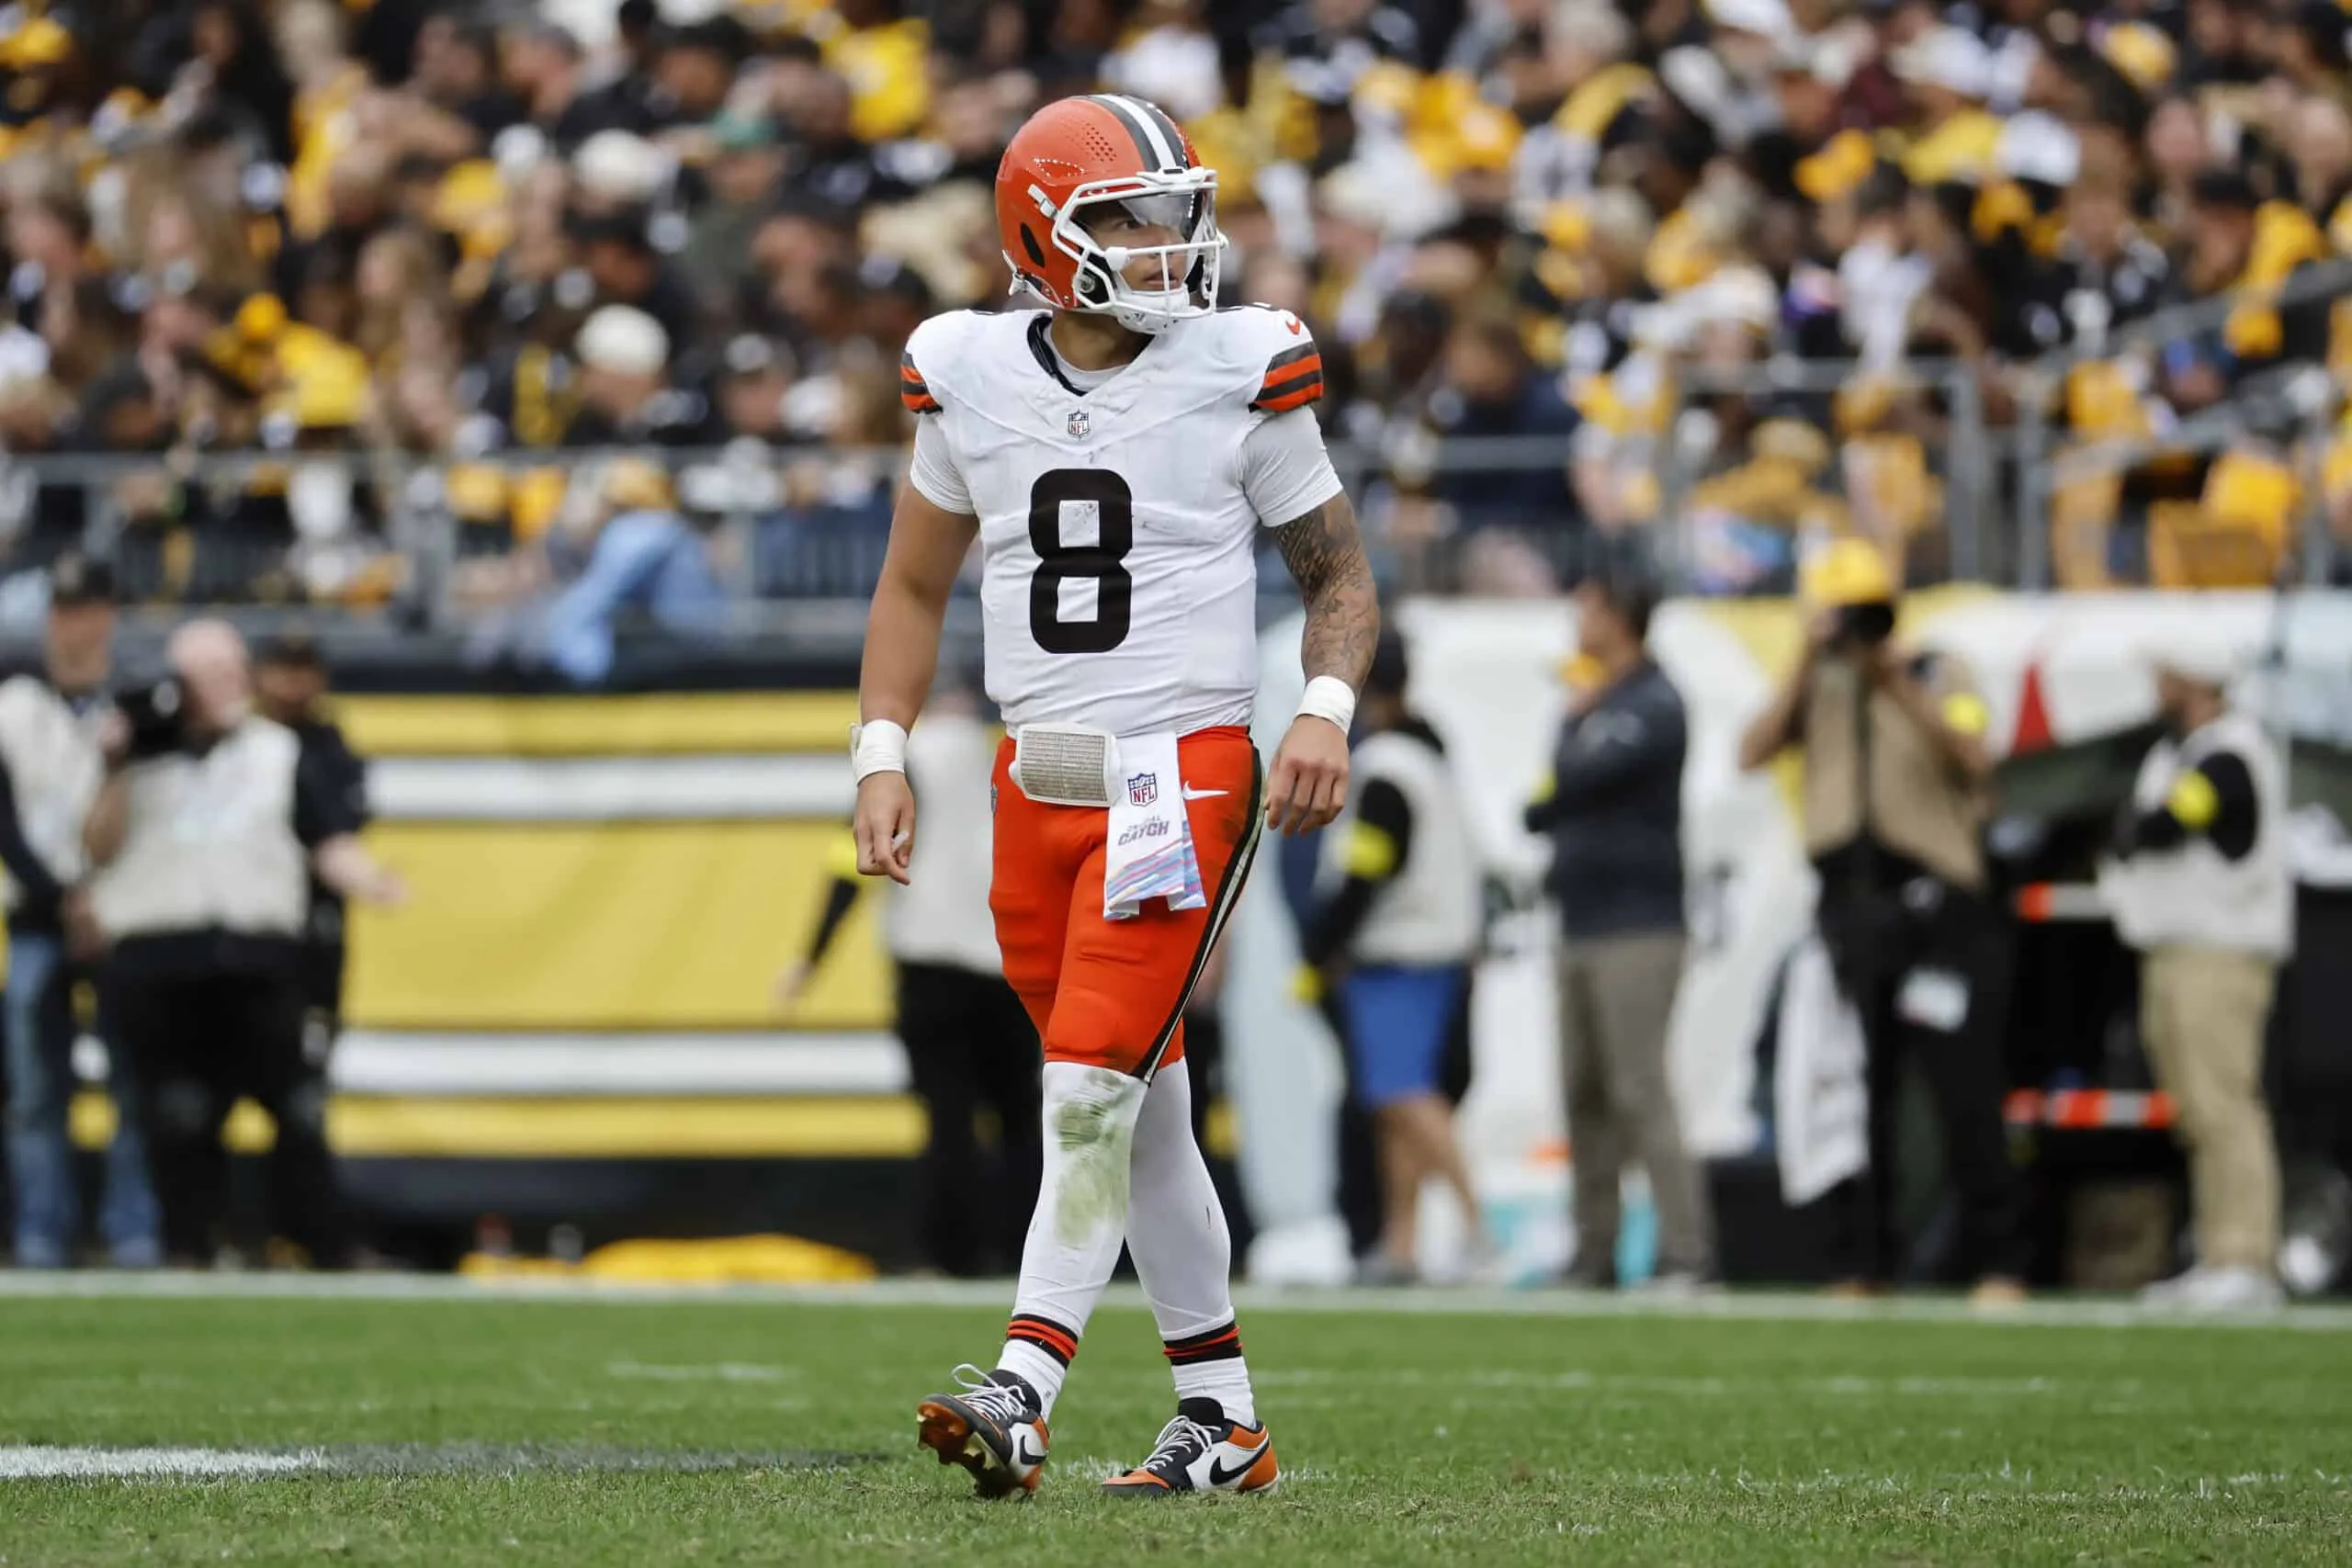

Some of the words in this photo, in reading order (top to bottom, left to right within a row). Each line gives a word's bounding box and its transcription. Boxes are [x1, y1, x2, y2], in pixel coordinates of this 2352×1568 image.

[1070, 422, 1088, 434] NFL
[1029, 468, 1133, 654] 8
[1133, 785, 1155, 804] NFL
[1118, 820, 1169, 846] CATCH
